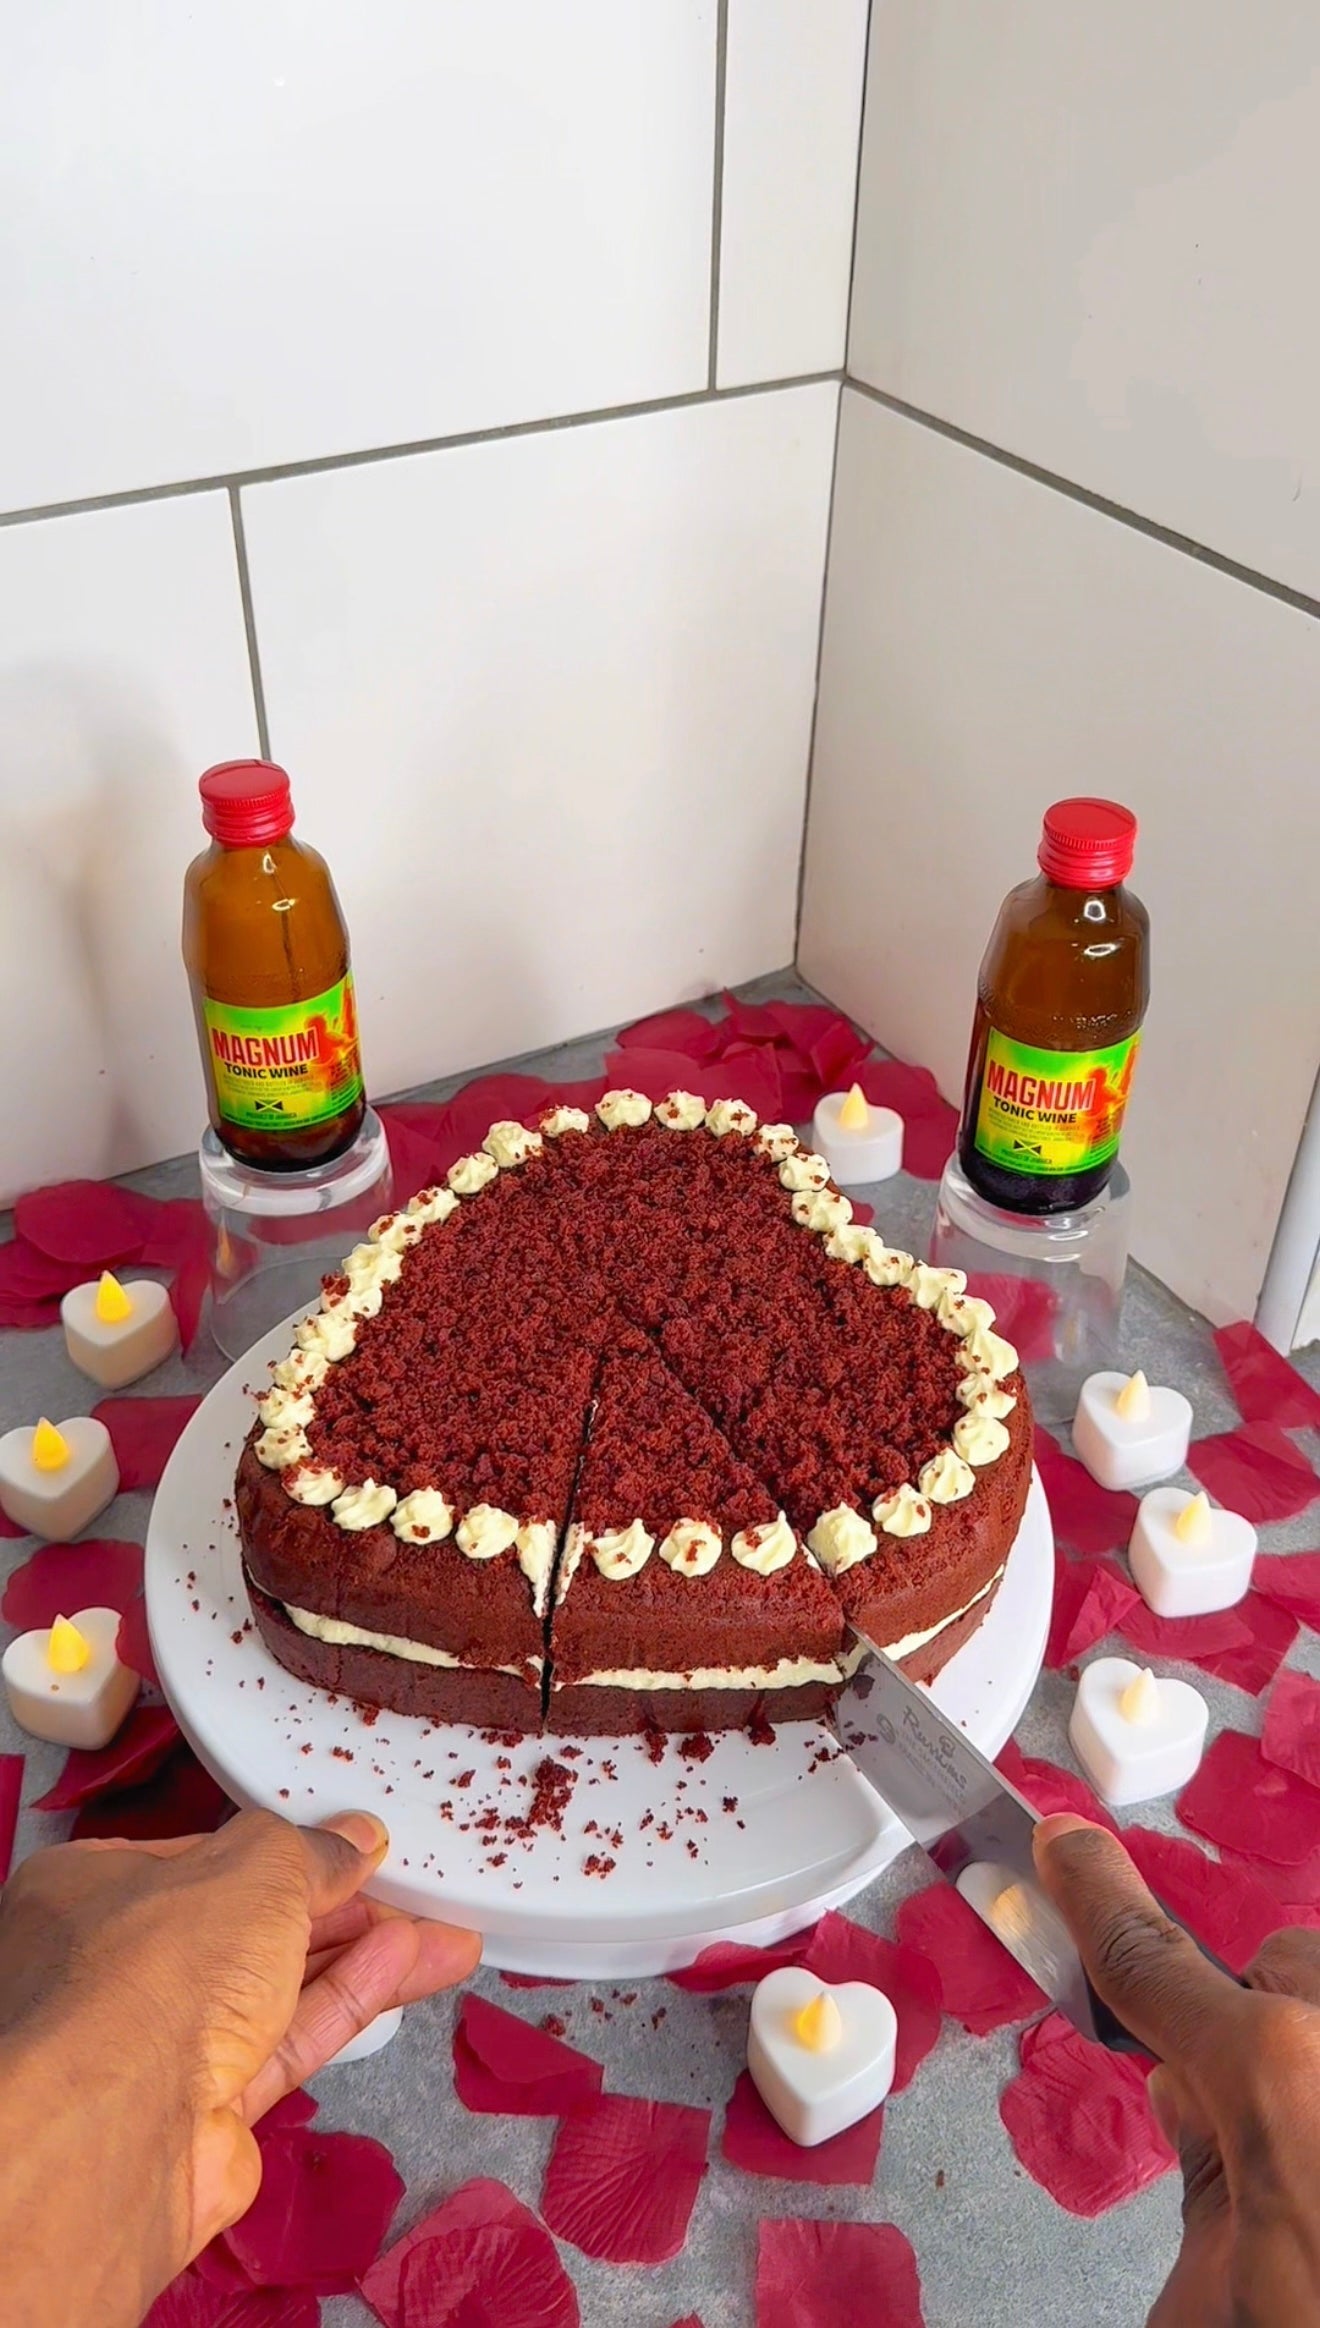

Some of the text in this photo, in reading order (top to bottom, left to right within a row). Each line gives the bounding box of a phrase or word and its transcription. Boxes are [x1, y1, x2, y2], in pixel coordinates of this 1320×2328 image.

[211, 1027, 318, 1067] MAGNUM
[224, 1062, 309, 1079] TONIC WINE
[986, 1059, 1095, 1111] MAGNUM
[993, 1096, 1077, 1124] TONIC WINE
